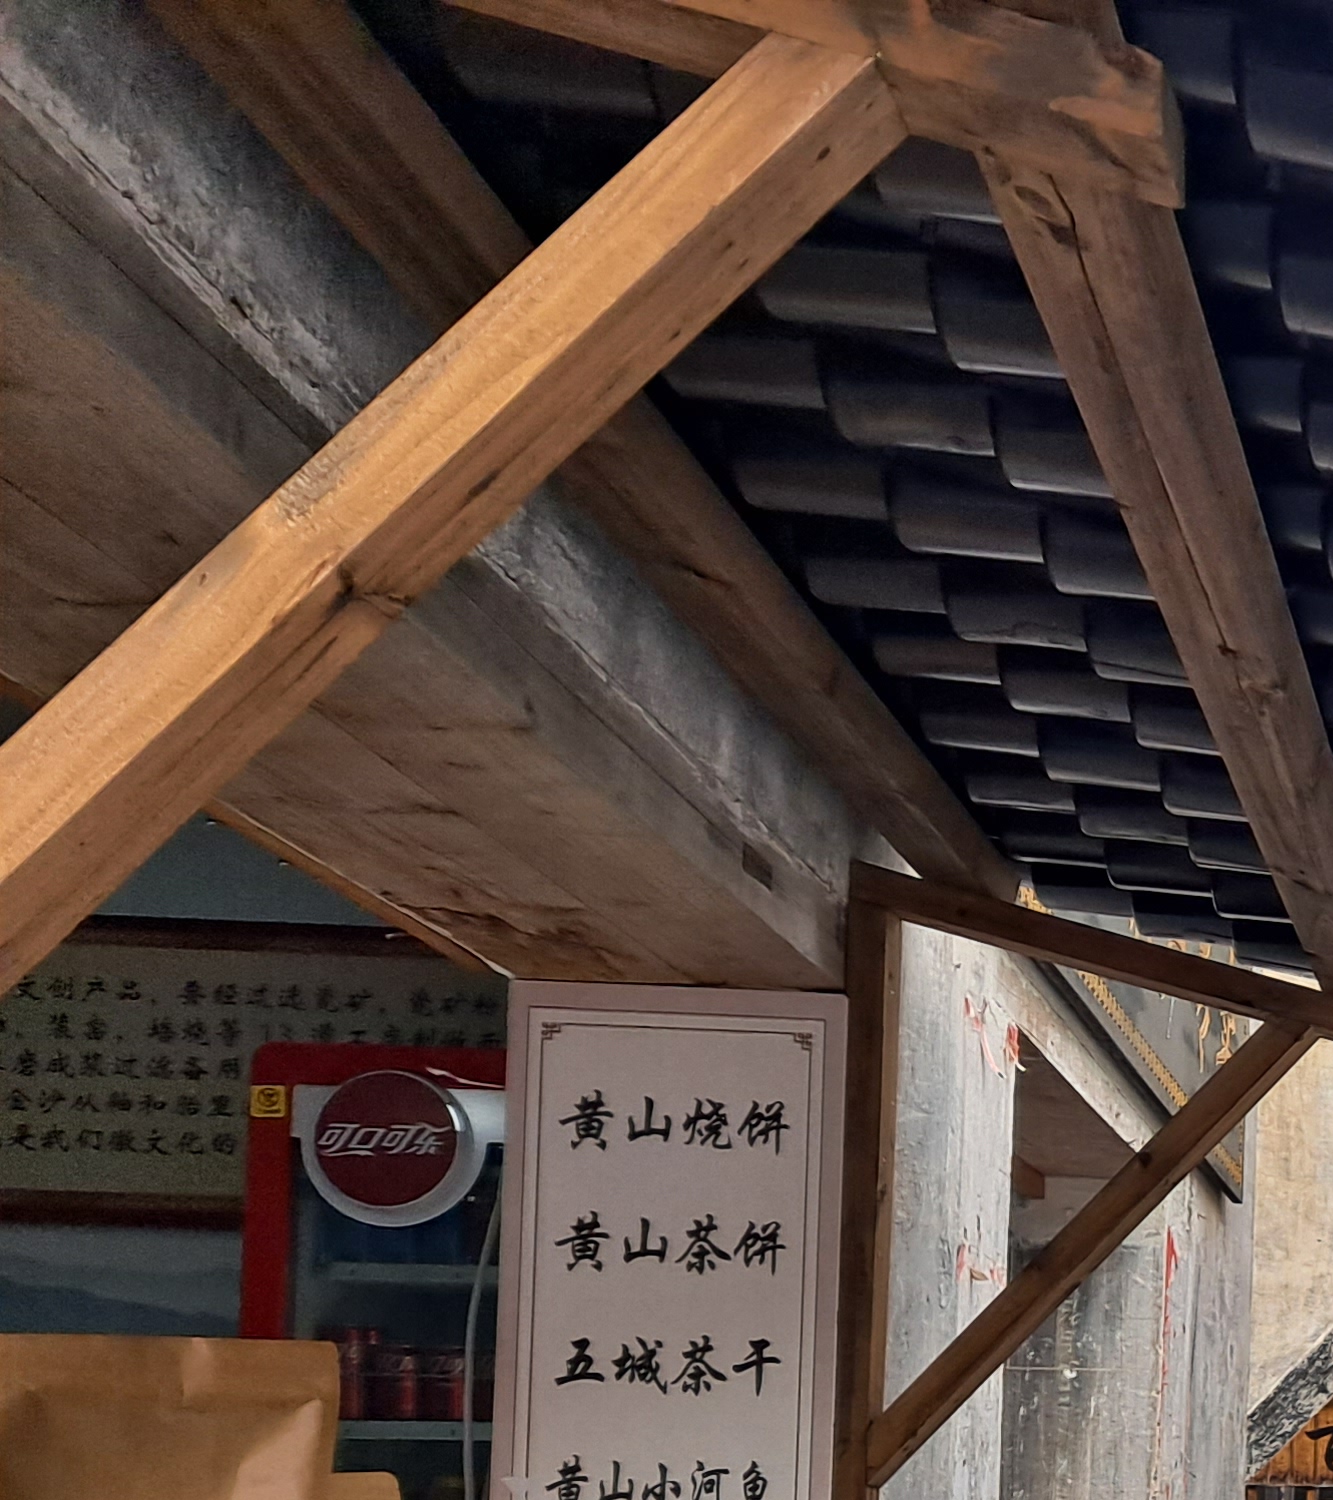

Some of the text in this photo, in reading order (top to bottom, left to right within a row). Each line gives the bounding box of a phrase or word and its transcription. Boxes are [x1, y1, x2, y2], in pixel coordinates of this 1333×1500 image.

[317, 1121, 453, 1157] 可口可乐
[559, 1089, 790, 1155] 黄山烧饼
[554, 1211, 786, 1276] 黄山茶饼
[554, 1335, 781, 1397] 五城茶干
